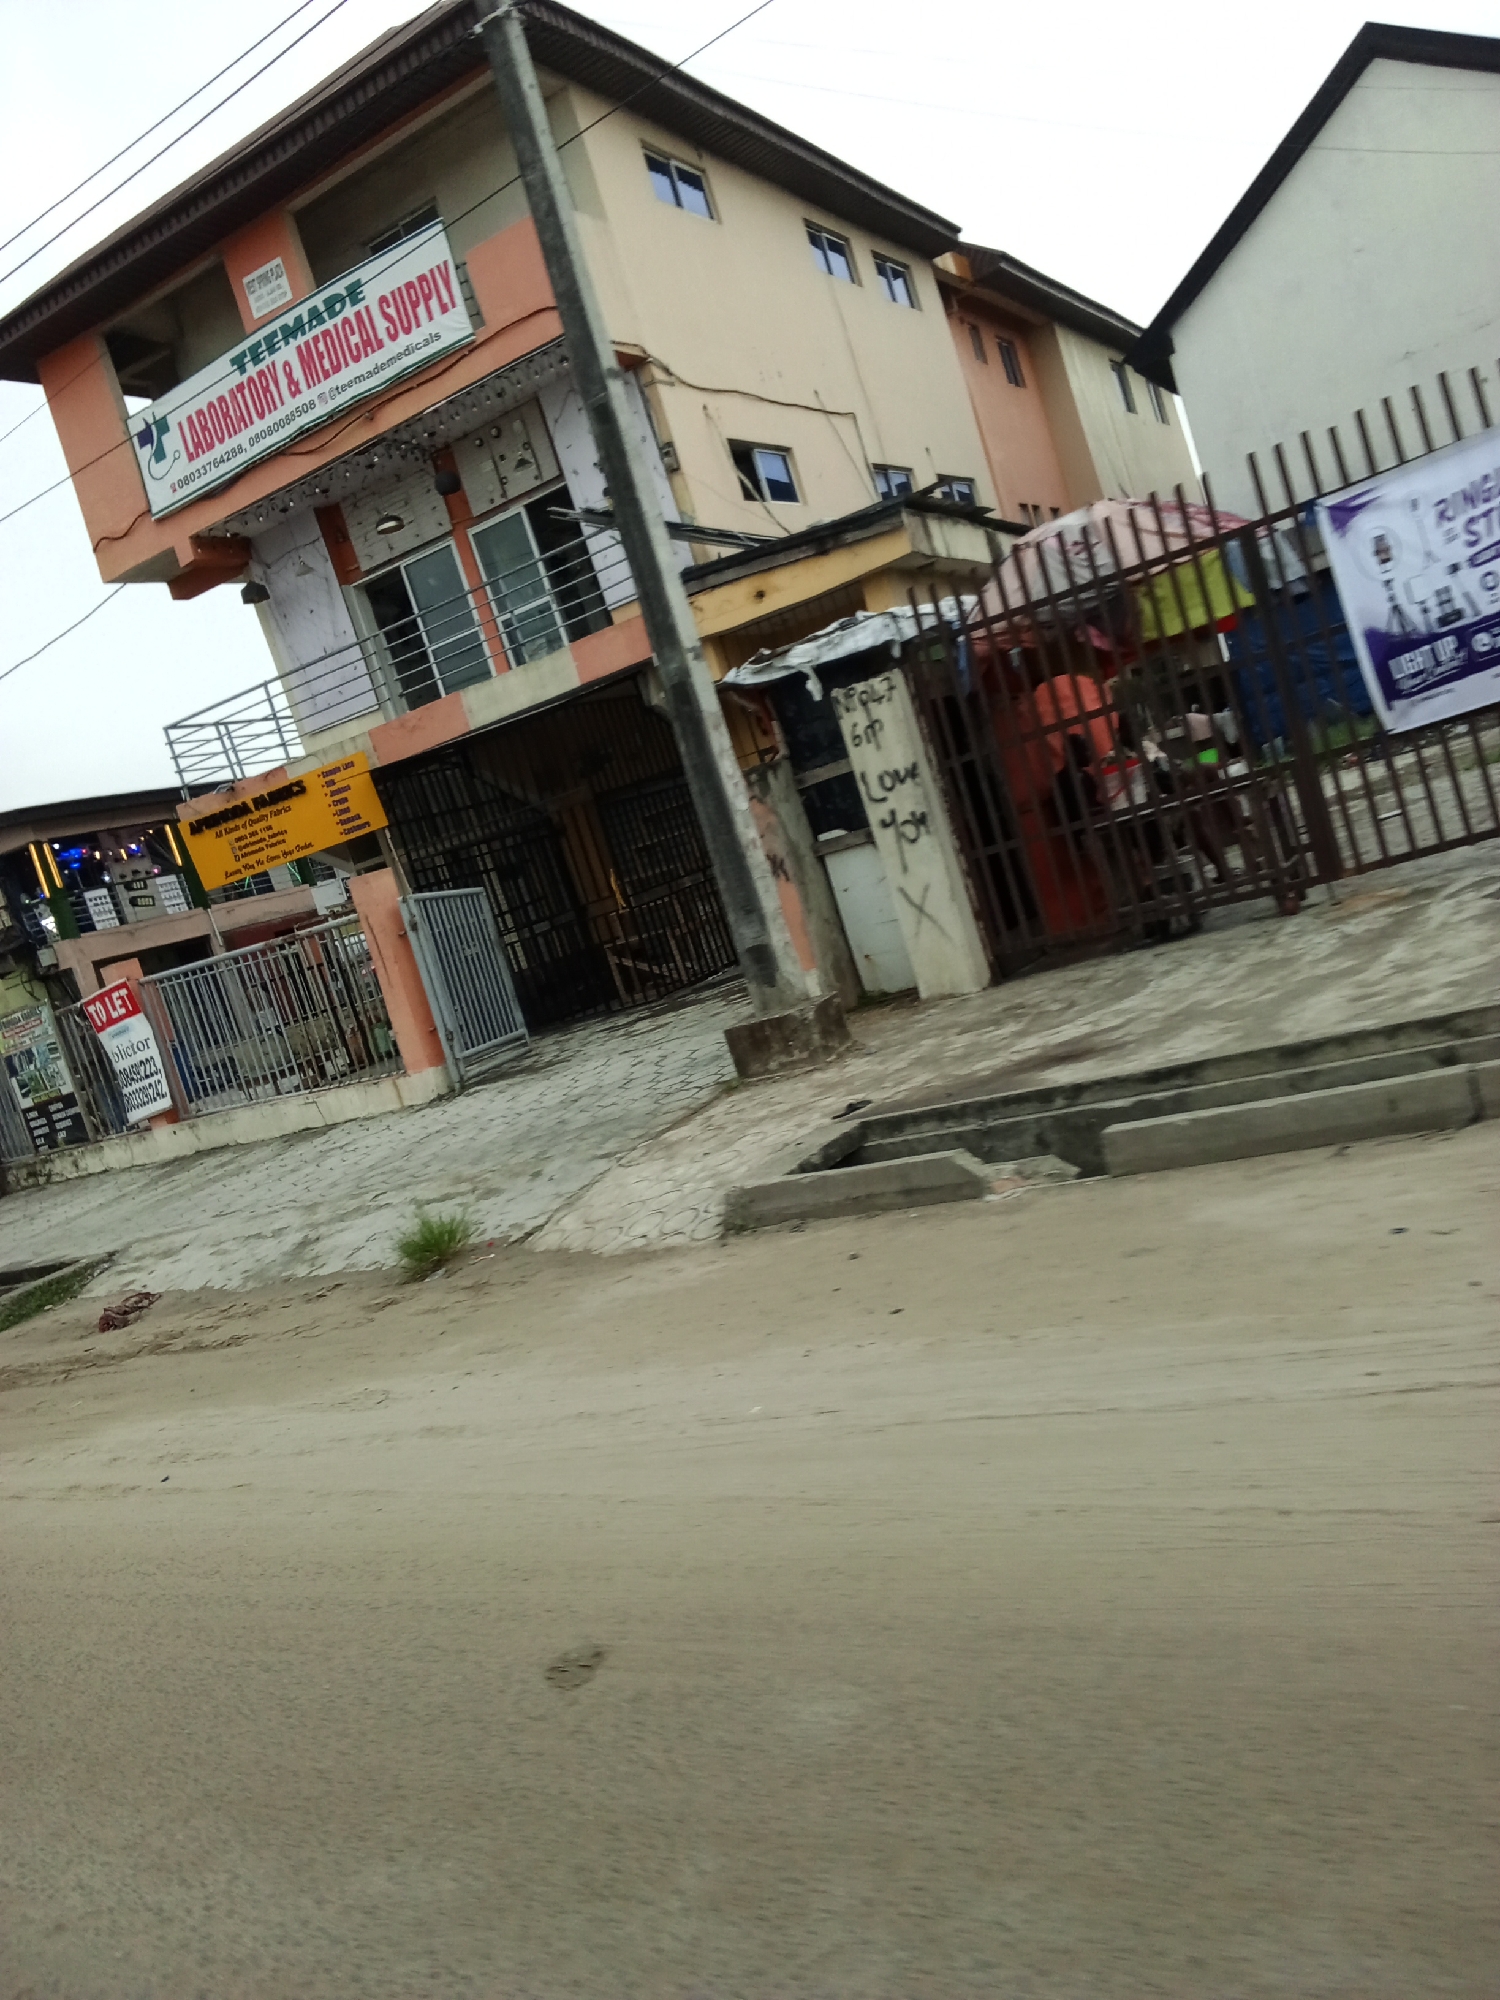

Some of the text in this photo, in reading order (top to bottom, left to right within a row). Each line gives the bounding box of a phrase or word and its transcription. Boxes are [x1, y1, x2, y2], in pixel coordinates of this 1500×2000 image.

[230, 278, 366, 376] TEEMADE
[178, 260, 457, 463] LABORATORY & MEDICAL SUPPLY
[177, 443, 247, 489] 08033764288,
[1463, 502, 1500, 548] ST
[87, 988, 133, 1027] TO LET
